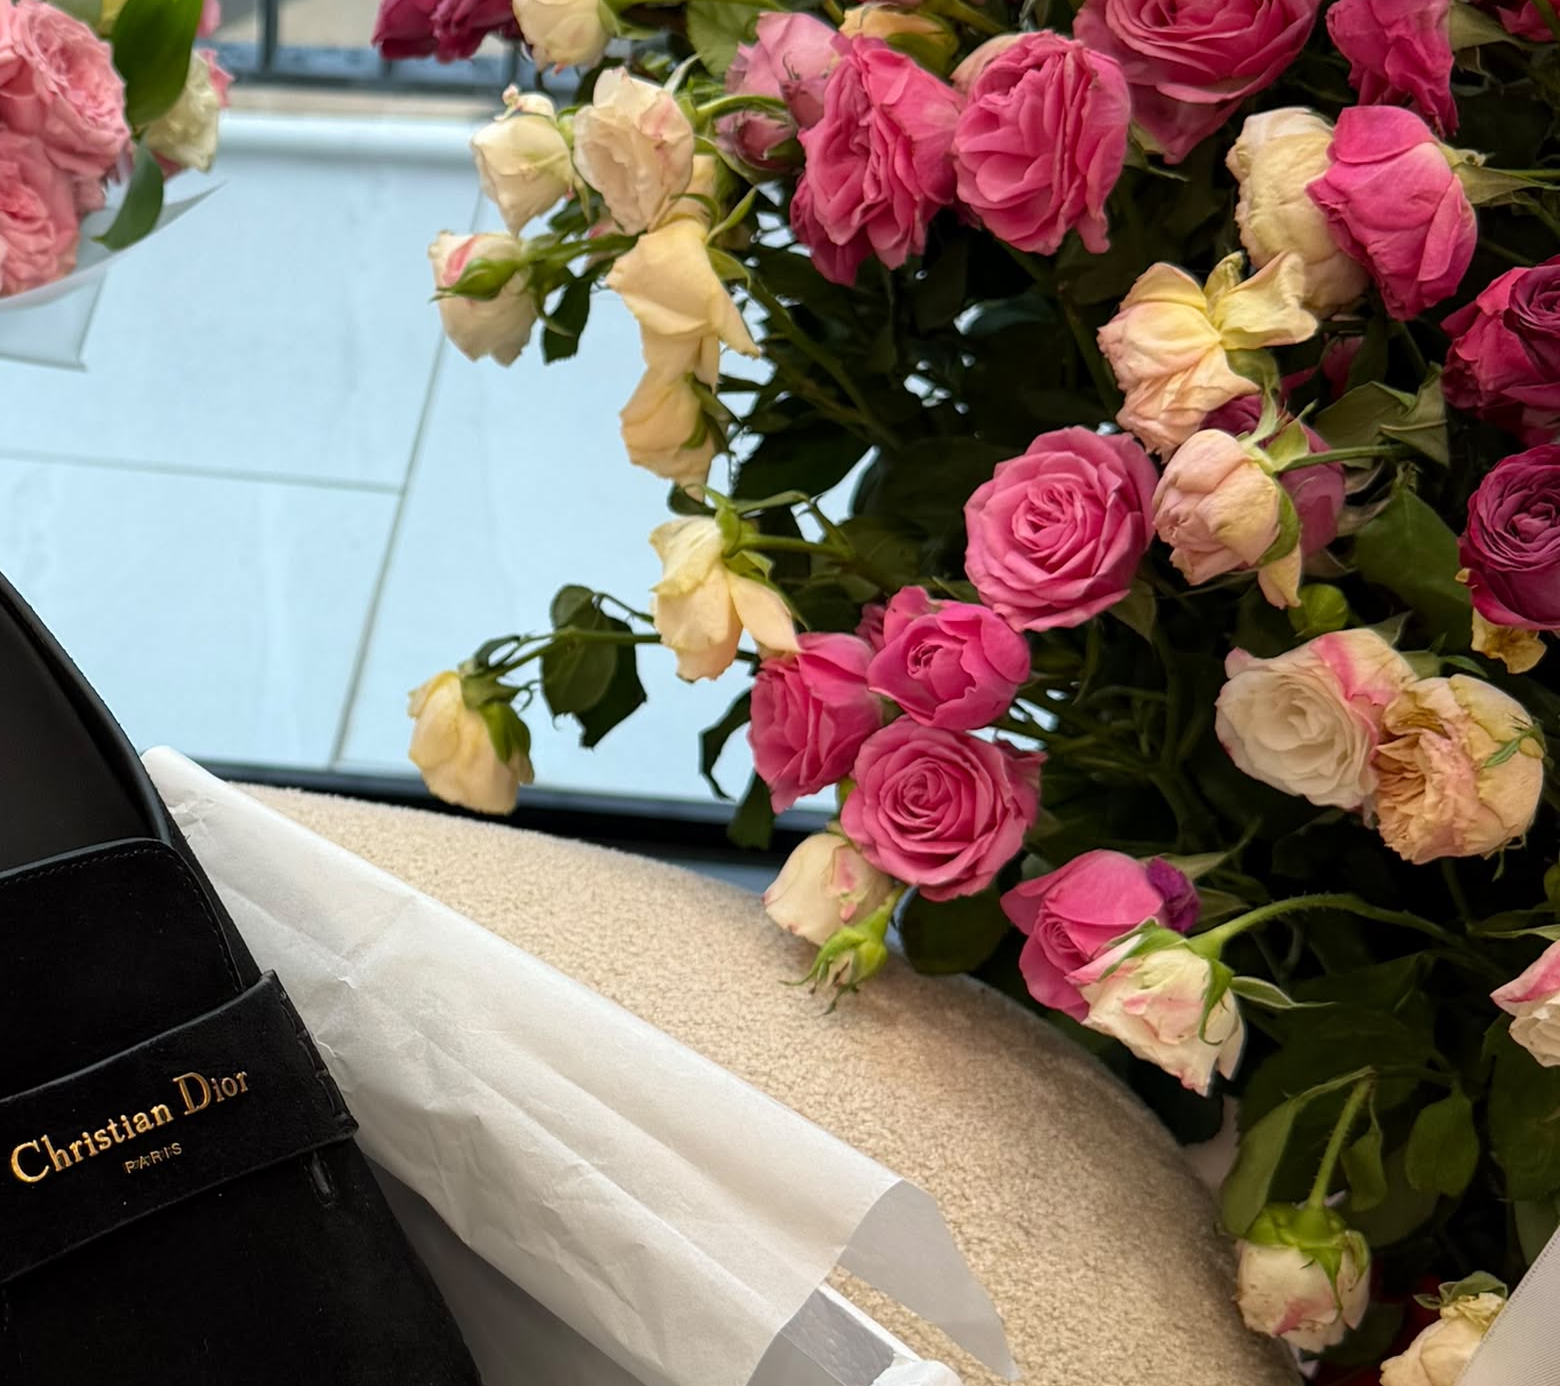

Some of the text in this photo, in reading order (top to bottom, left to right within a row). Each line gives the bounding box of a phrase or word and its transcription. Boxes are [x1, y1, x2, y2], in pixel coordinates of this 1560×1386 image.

[8, 1071, 248, 1184] Christian Dior
[123, 1142, 182, 1174] PARIS
